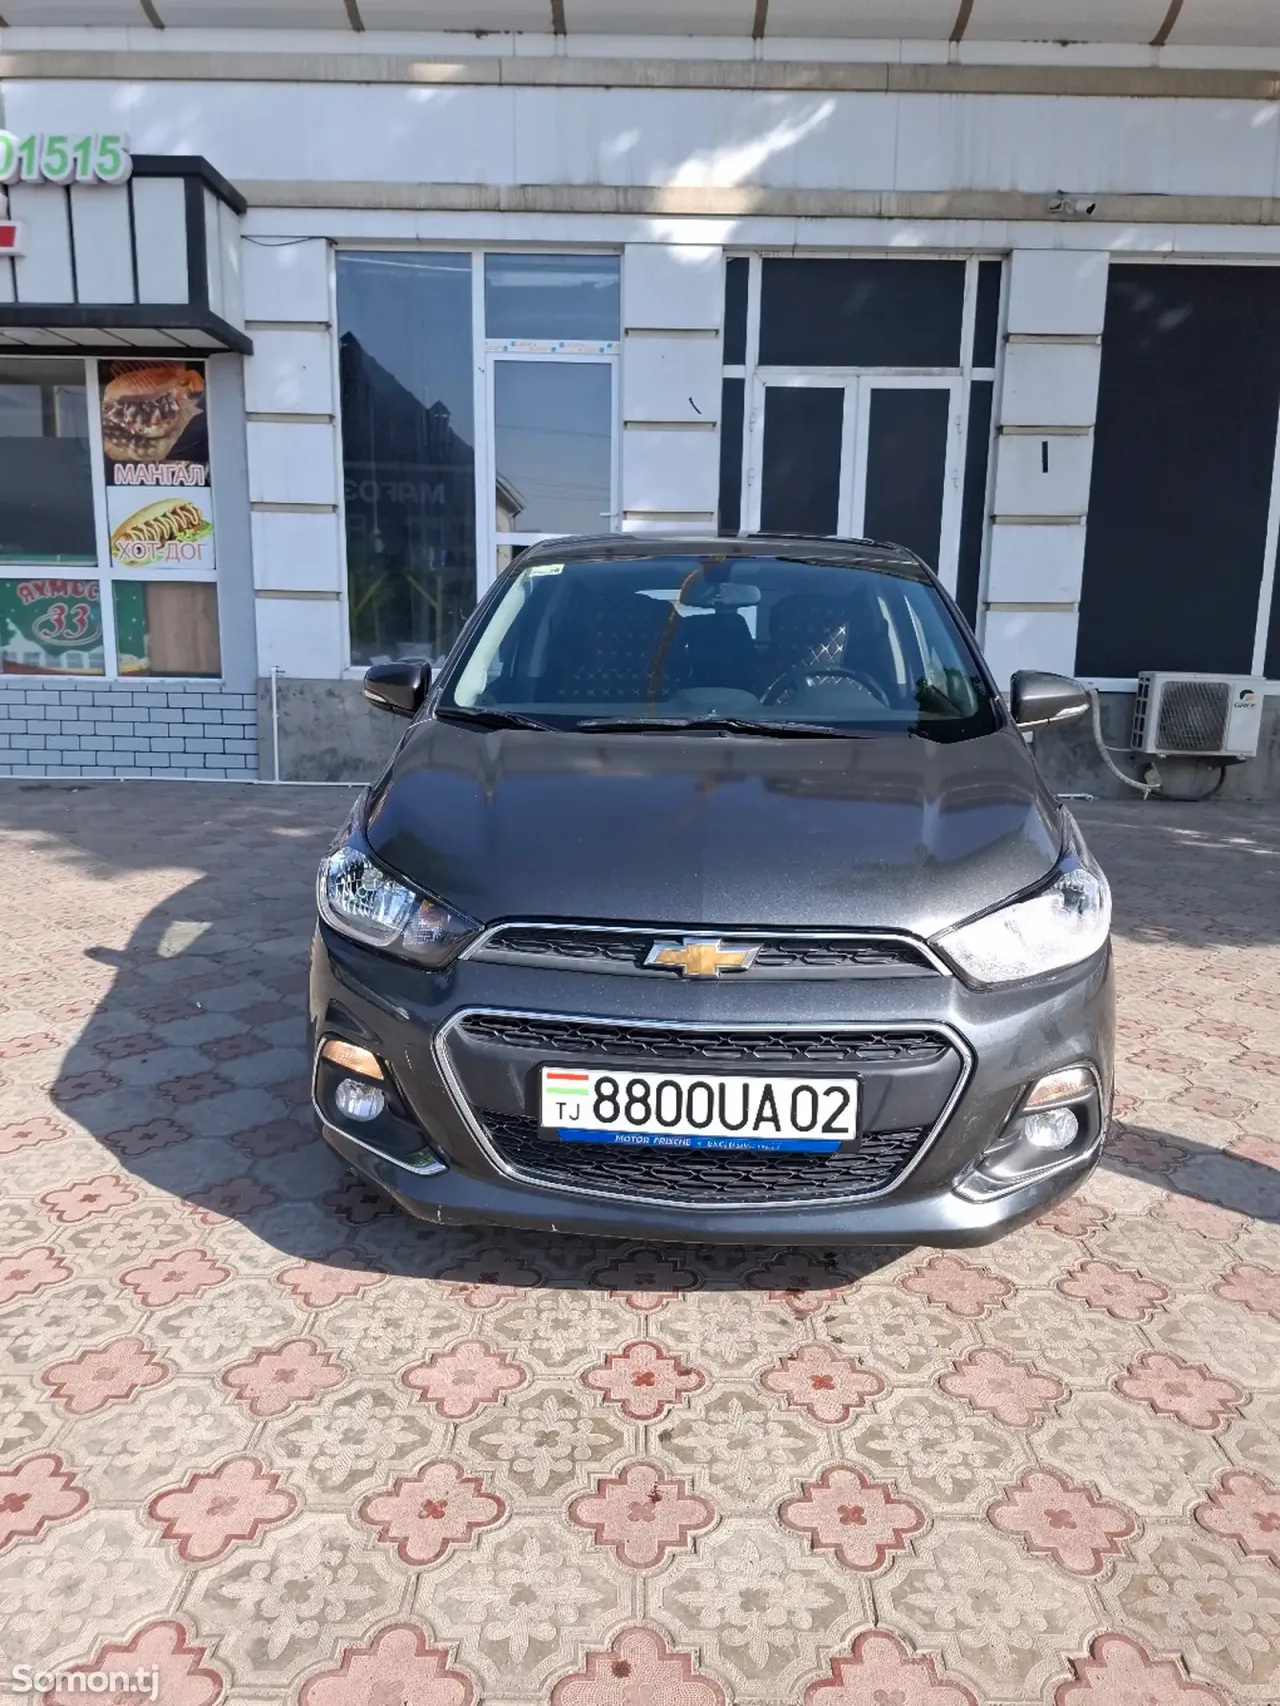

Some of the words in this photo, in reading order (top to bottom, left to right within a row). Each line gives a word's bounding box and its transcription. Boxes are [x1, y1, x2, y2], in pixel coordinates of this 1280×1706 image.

[114, 463, 205, 486] МАНГАЛ
[116, 542, 208, 562] ХОТ-ДОГ
[41, 603, 90, 639] 33
[555, 1102, 580, 1121] TJ
[614, 1134, 650, 1145] MOTOR
